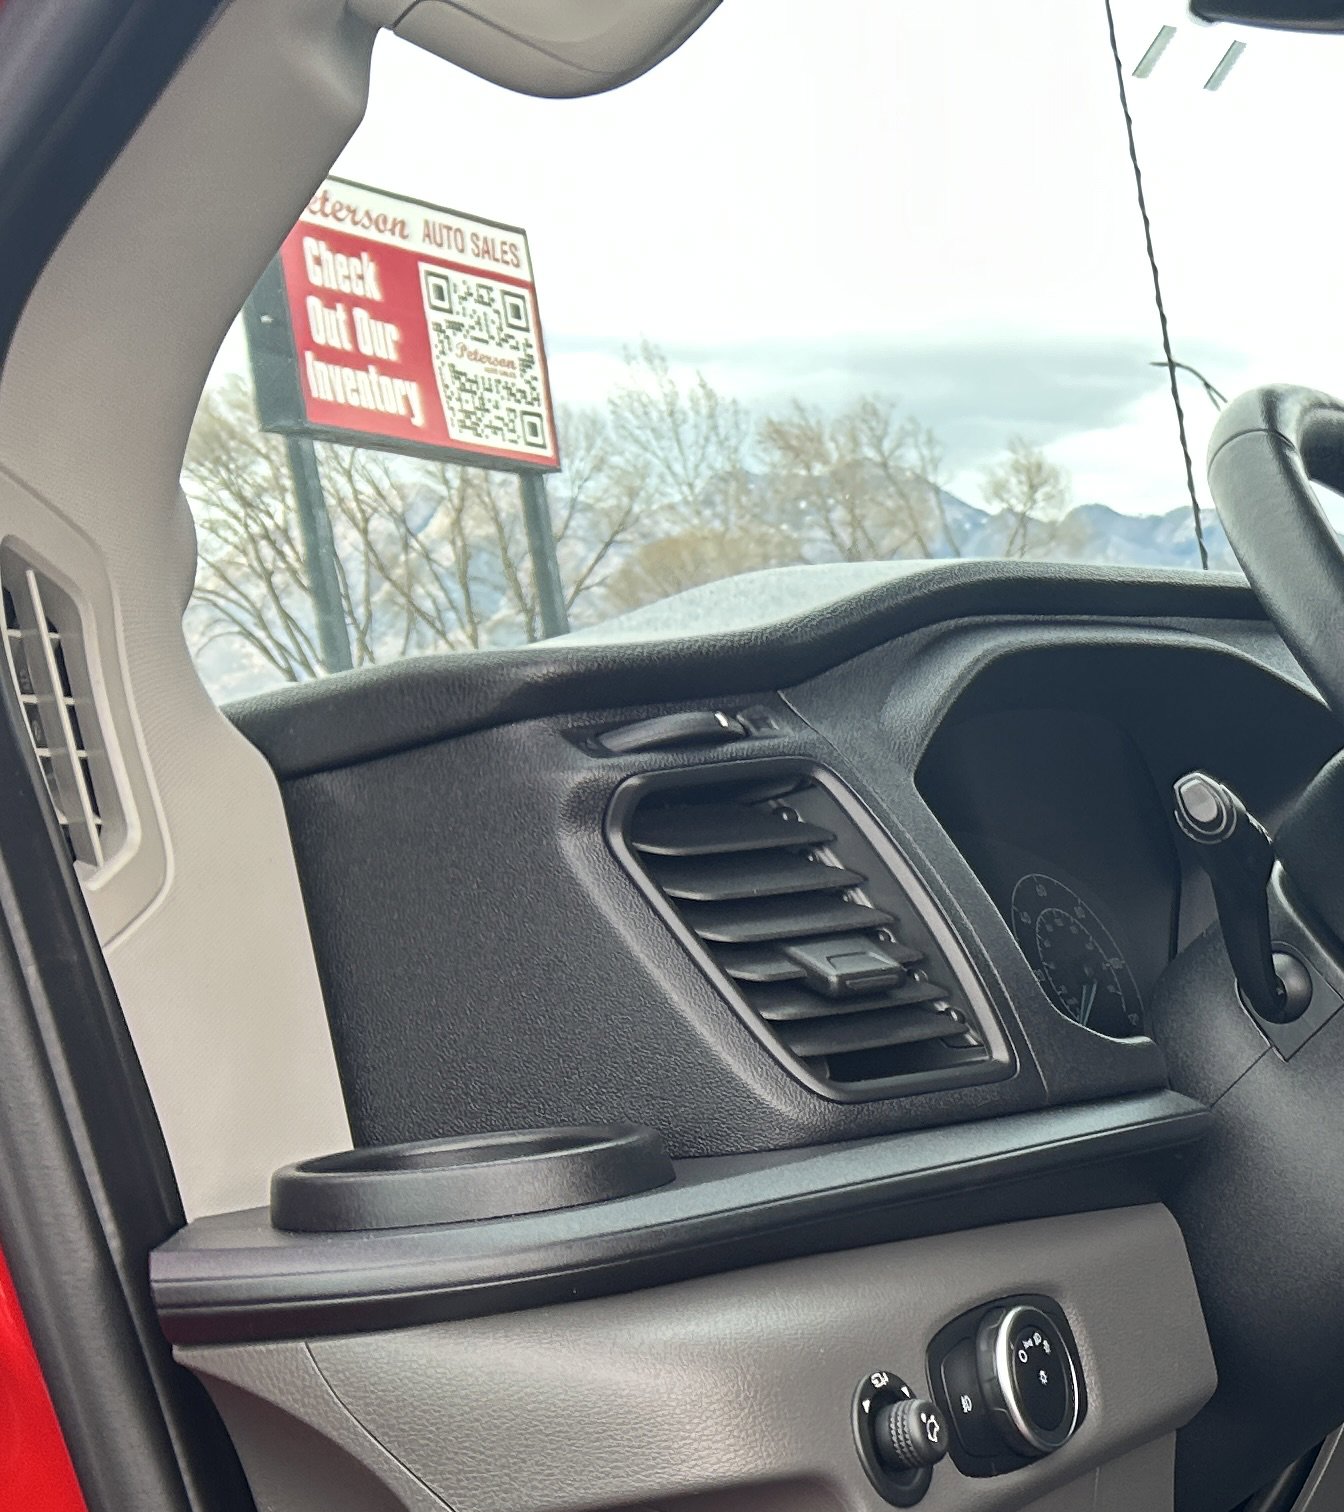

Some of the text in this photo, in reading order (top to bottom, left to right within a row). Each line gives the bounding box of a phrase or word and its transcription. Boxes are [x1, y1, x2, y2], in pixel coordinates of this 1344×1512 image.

[304, 190, 521, 269] eterson AUTO SALES
[302, 235, 381, 302] Check
[306, 294, 400, 361] Out Our
[304, 350, 426, 428] Inventory
